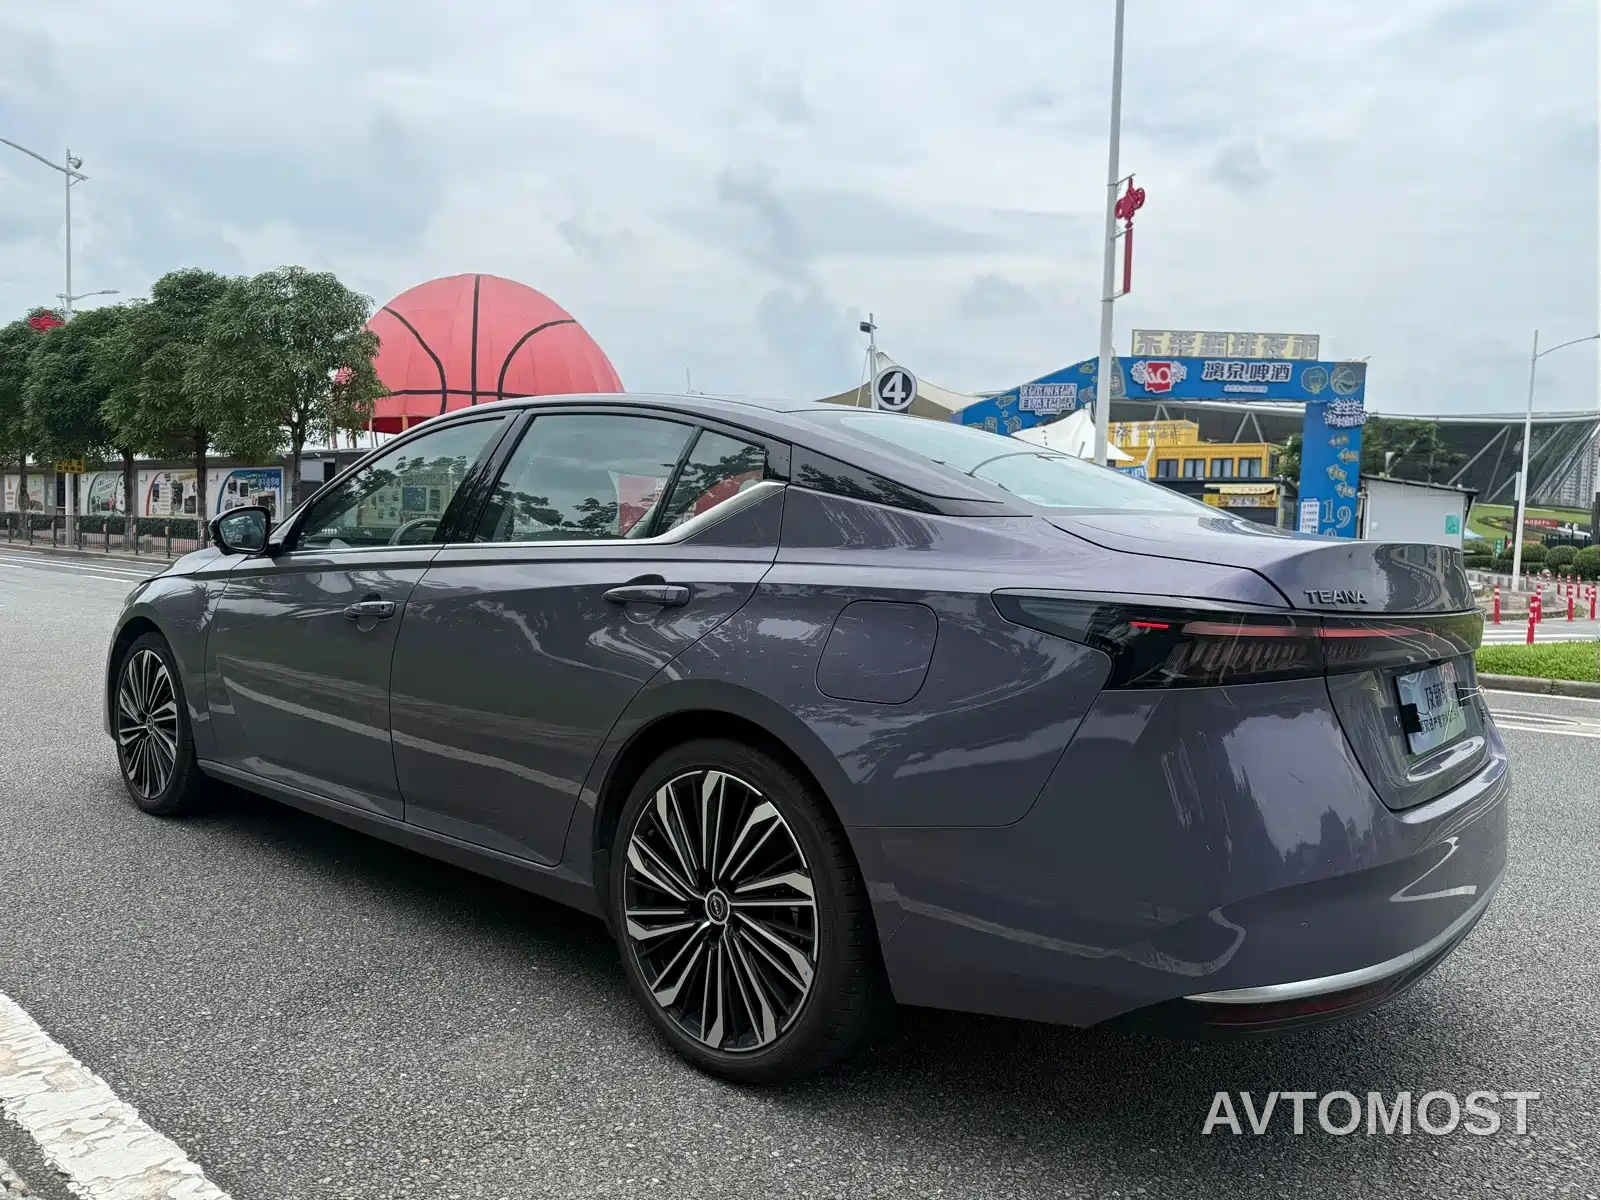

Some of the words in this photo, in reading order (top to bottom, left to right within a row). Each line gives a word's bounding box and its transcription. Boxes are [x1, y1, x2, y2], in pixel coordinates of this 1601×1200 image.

[1134, 332, 1318, 359] 东莞篮球夜市
[1202, 361, 1292, 382] 漓泉啤酒
[882, 372, 906, 405] 4
[1304, 589, 1368, 605] TEANA
